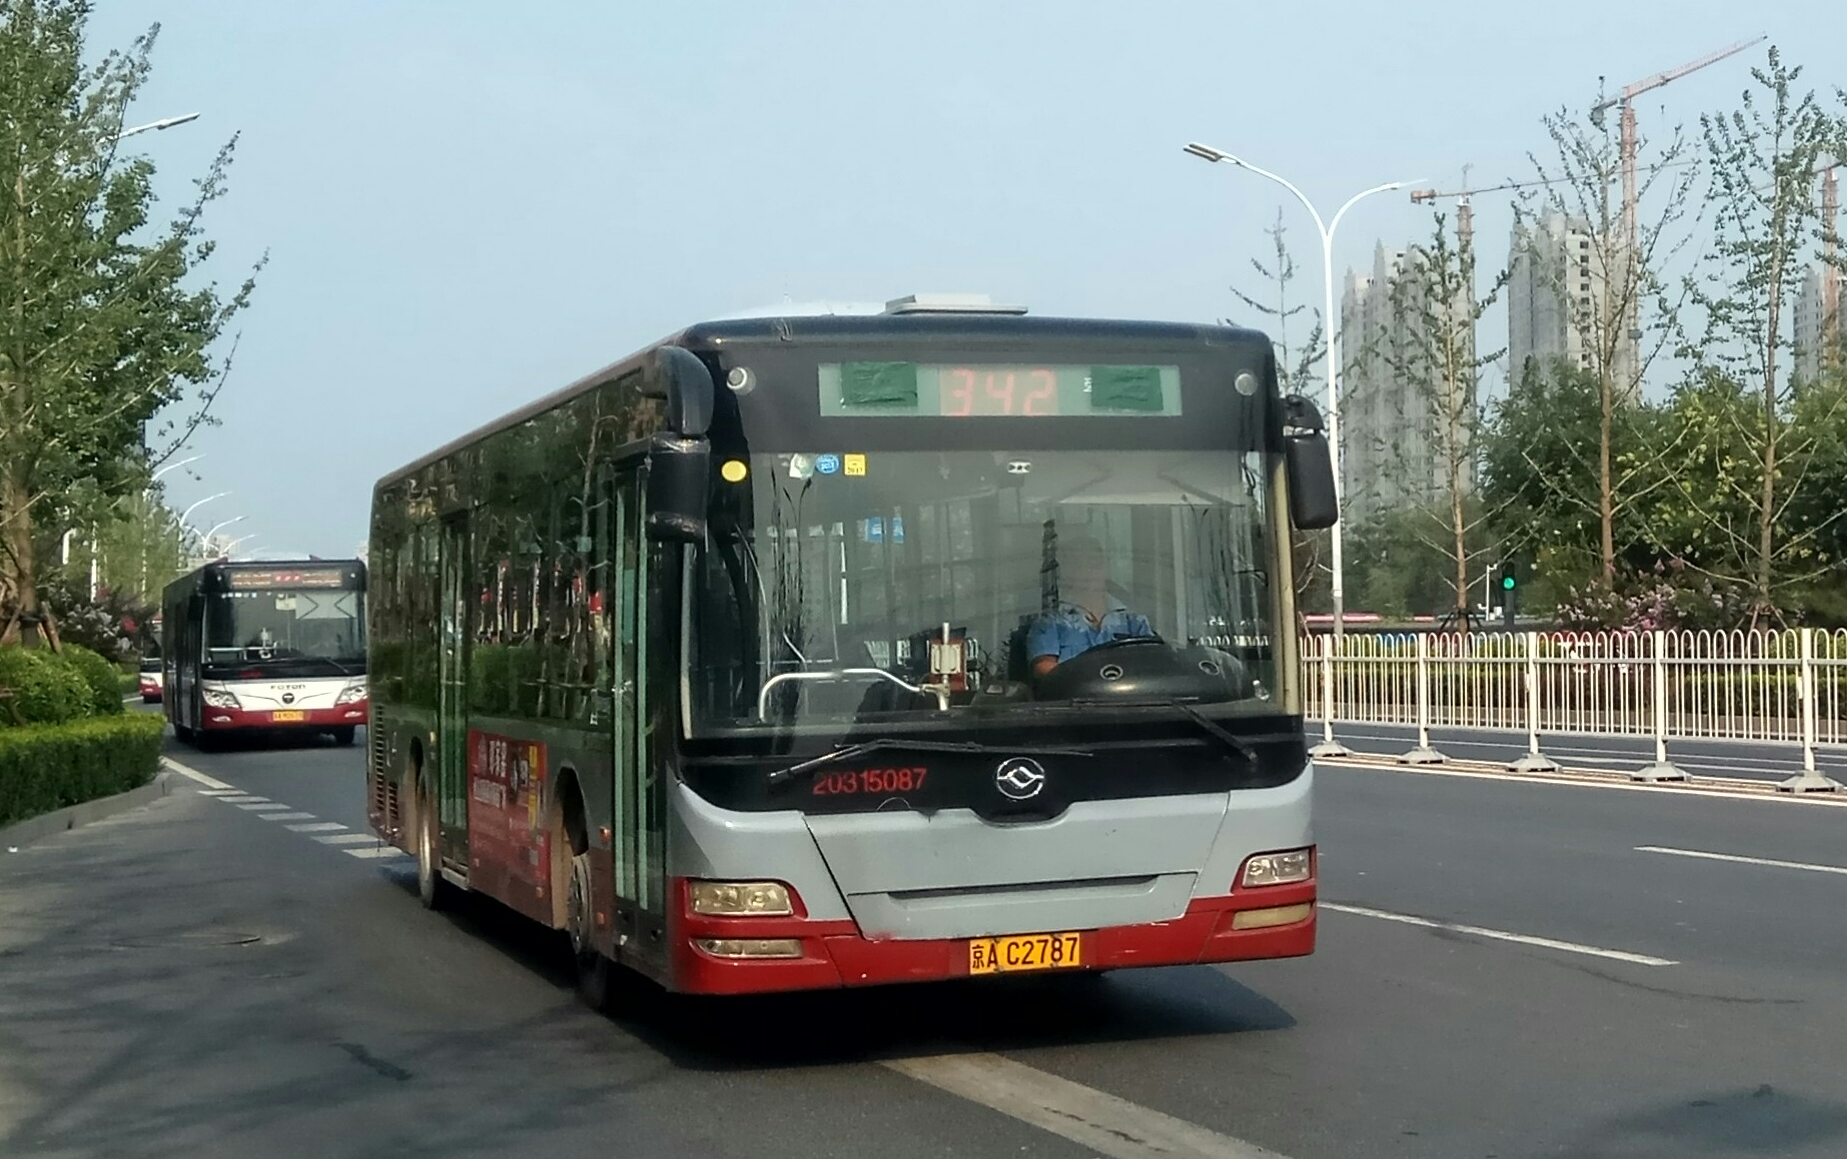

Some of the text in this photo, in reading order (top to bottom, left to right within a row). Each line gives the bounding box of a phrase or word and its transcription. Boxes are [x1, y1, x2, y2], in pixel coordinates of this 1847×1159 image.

[951, 368, 1054, 416] 342
[813, 767, 927, 795] 20315087
[972, 937, 1078, 968] 京A C2787
